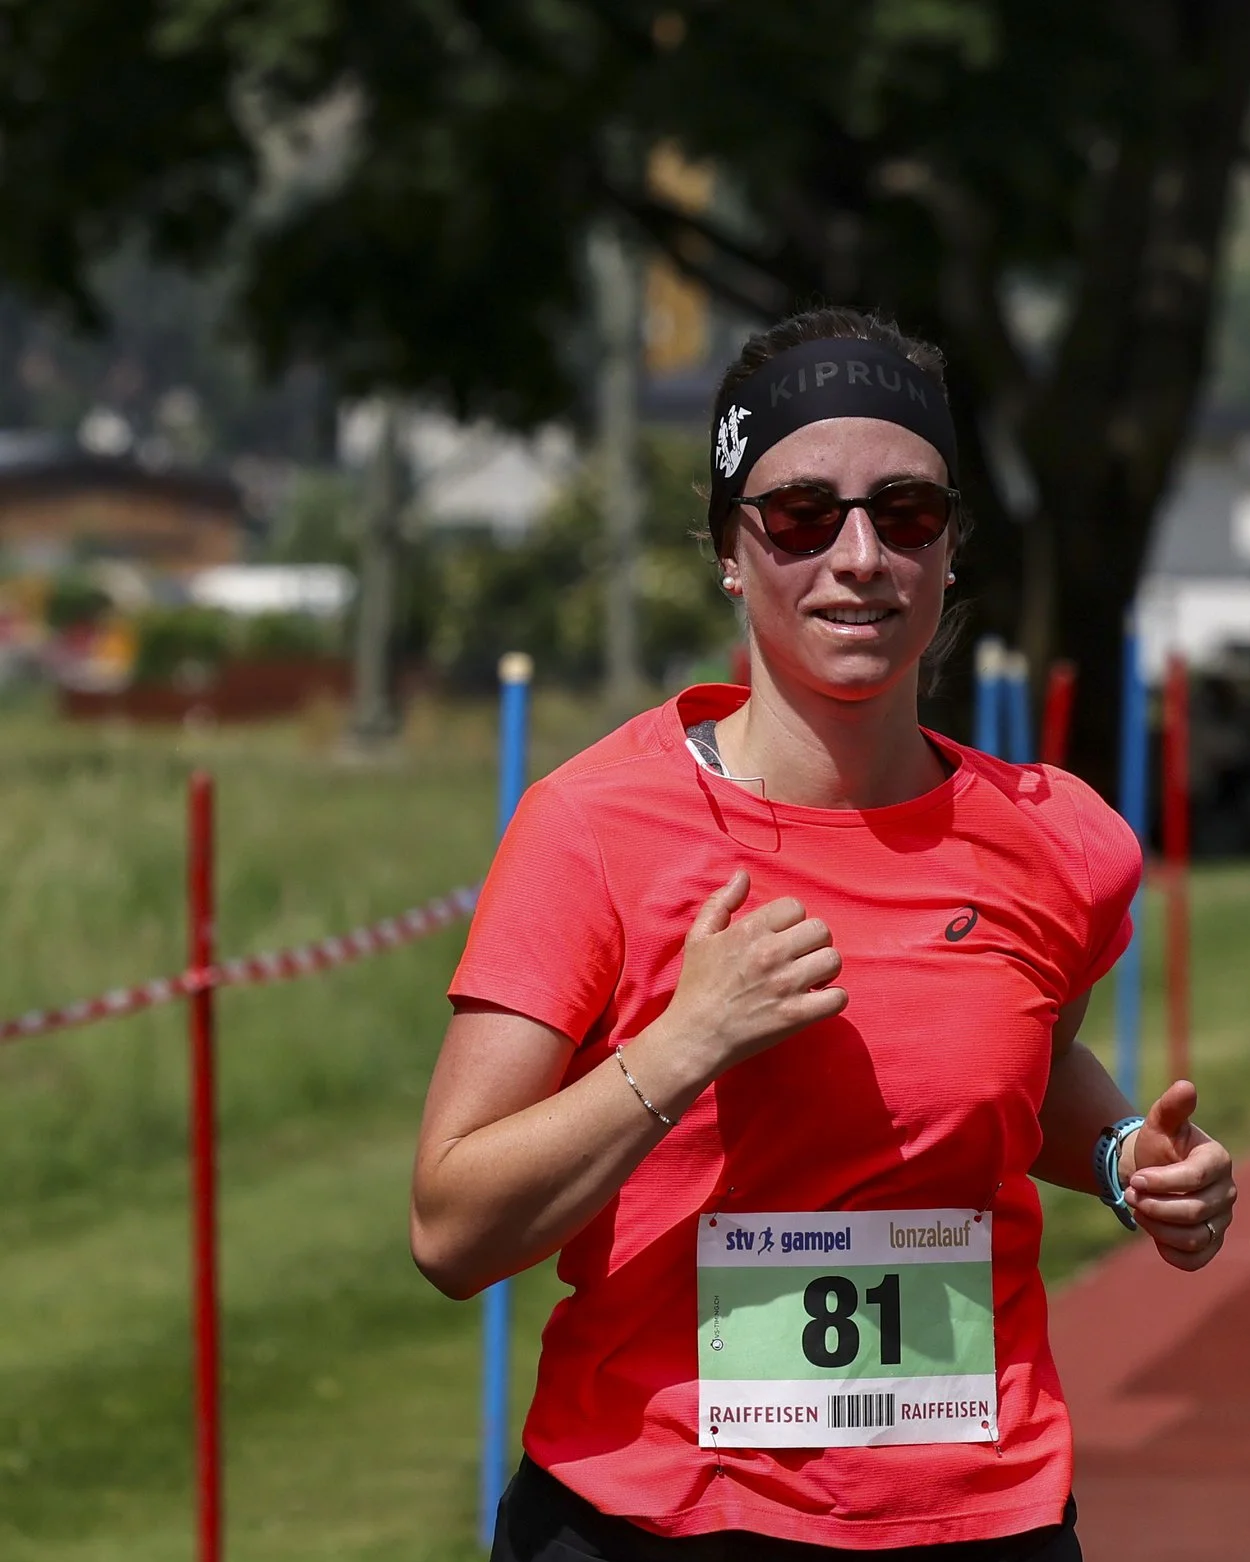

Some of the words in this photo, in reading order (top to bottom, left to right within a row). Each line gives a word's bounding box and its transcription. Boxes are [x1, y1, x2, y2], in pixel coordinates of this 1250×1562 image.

[769, 360, 928, 409] KIPRUN
[725, 1228, 755, 1251] stv
[781, 1226, 851, 1253] gampel
[889, 1220, 972, 1249] lonzalauf
[801, 1273, 901, 1369] 81
[709, 1405, 819, 1424] RAIFFEISEN
[901, 1400, 989, 1421] RAIFFEISEN
